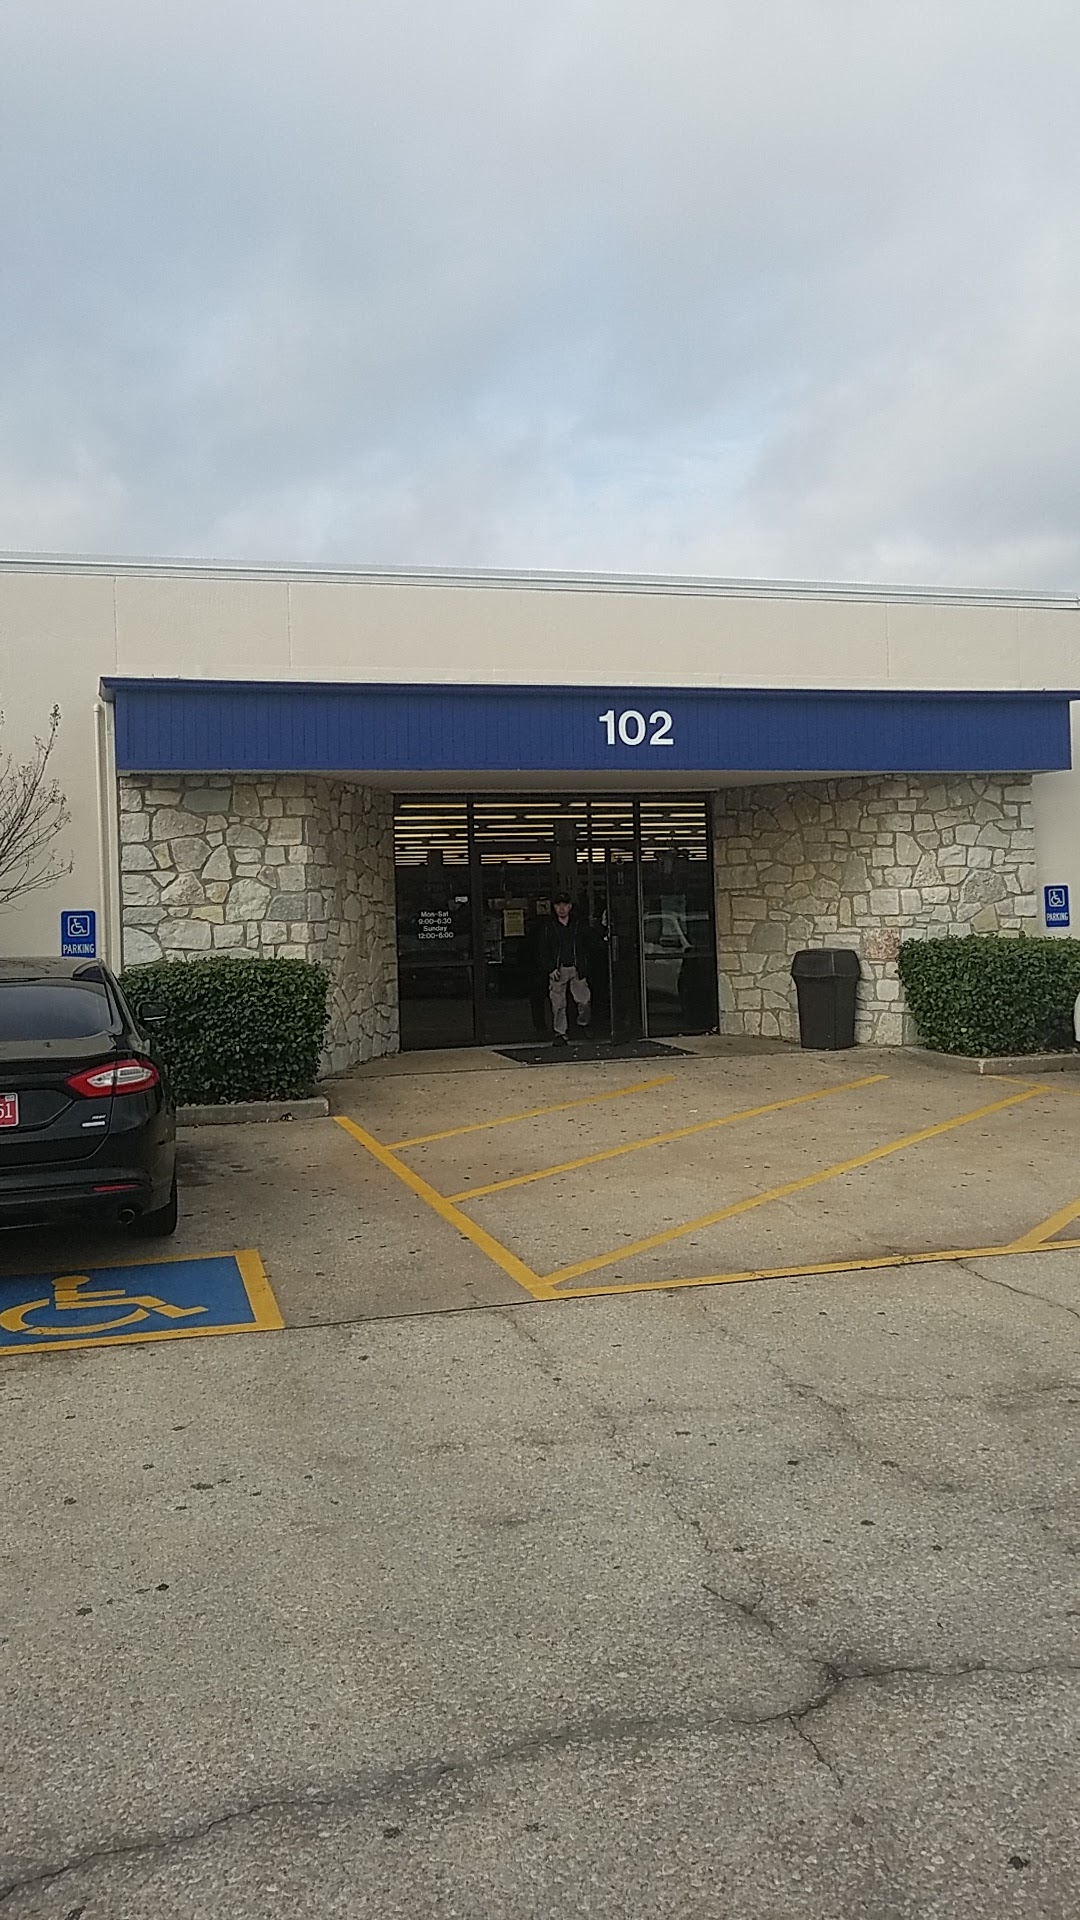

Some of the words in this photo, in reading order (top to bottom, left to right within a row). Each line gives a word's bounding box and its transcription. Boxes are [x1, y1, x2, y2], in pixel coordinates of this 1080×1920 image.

[598, 709, 674, 746] 102
[1046, 912, 1068, 921] PARKING
[62, 944, 94, 954] PARKING
